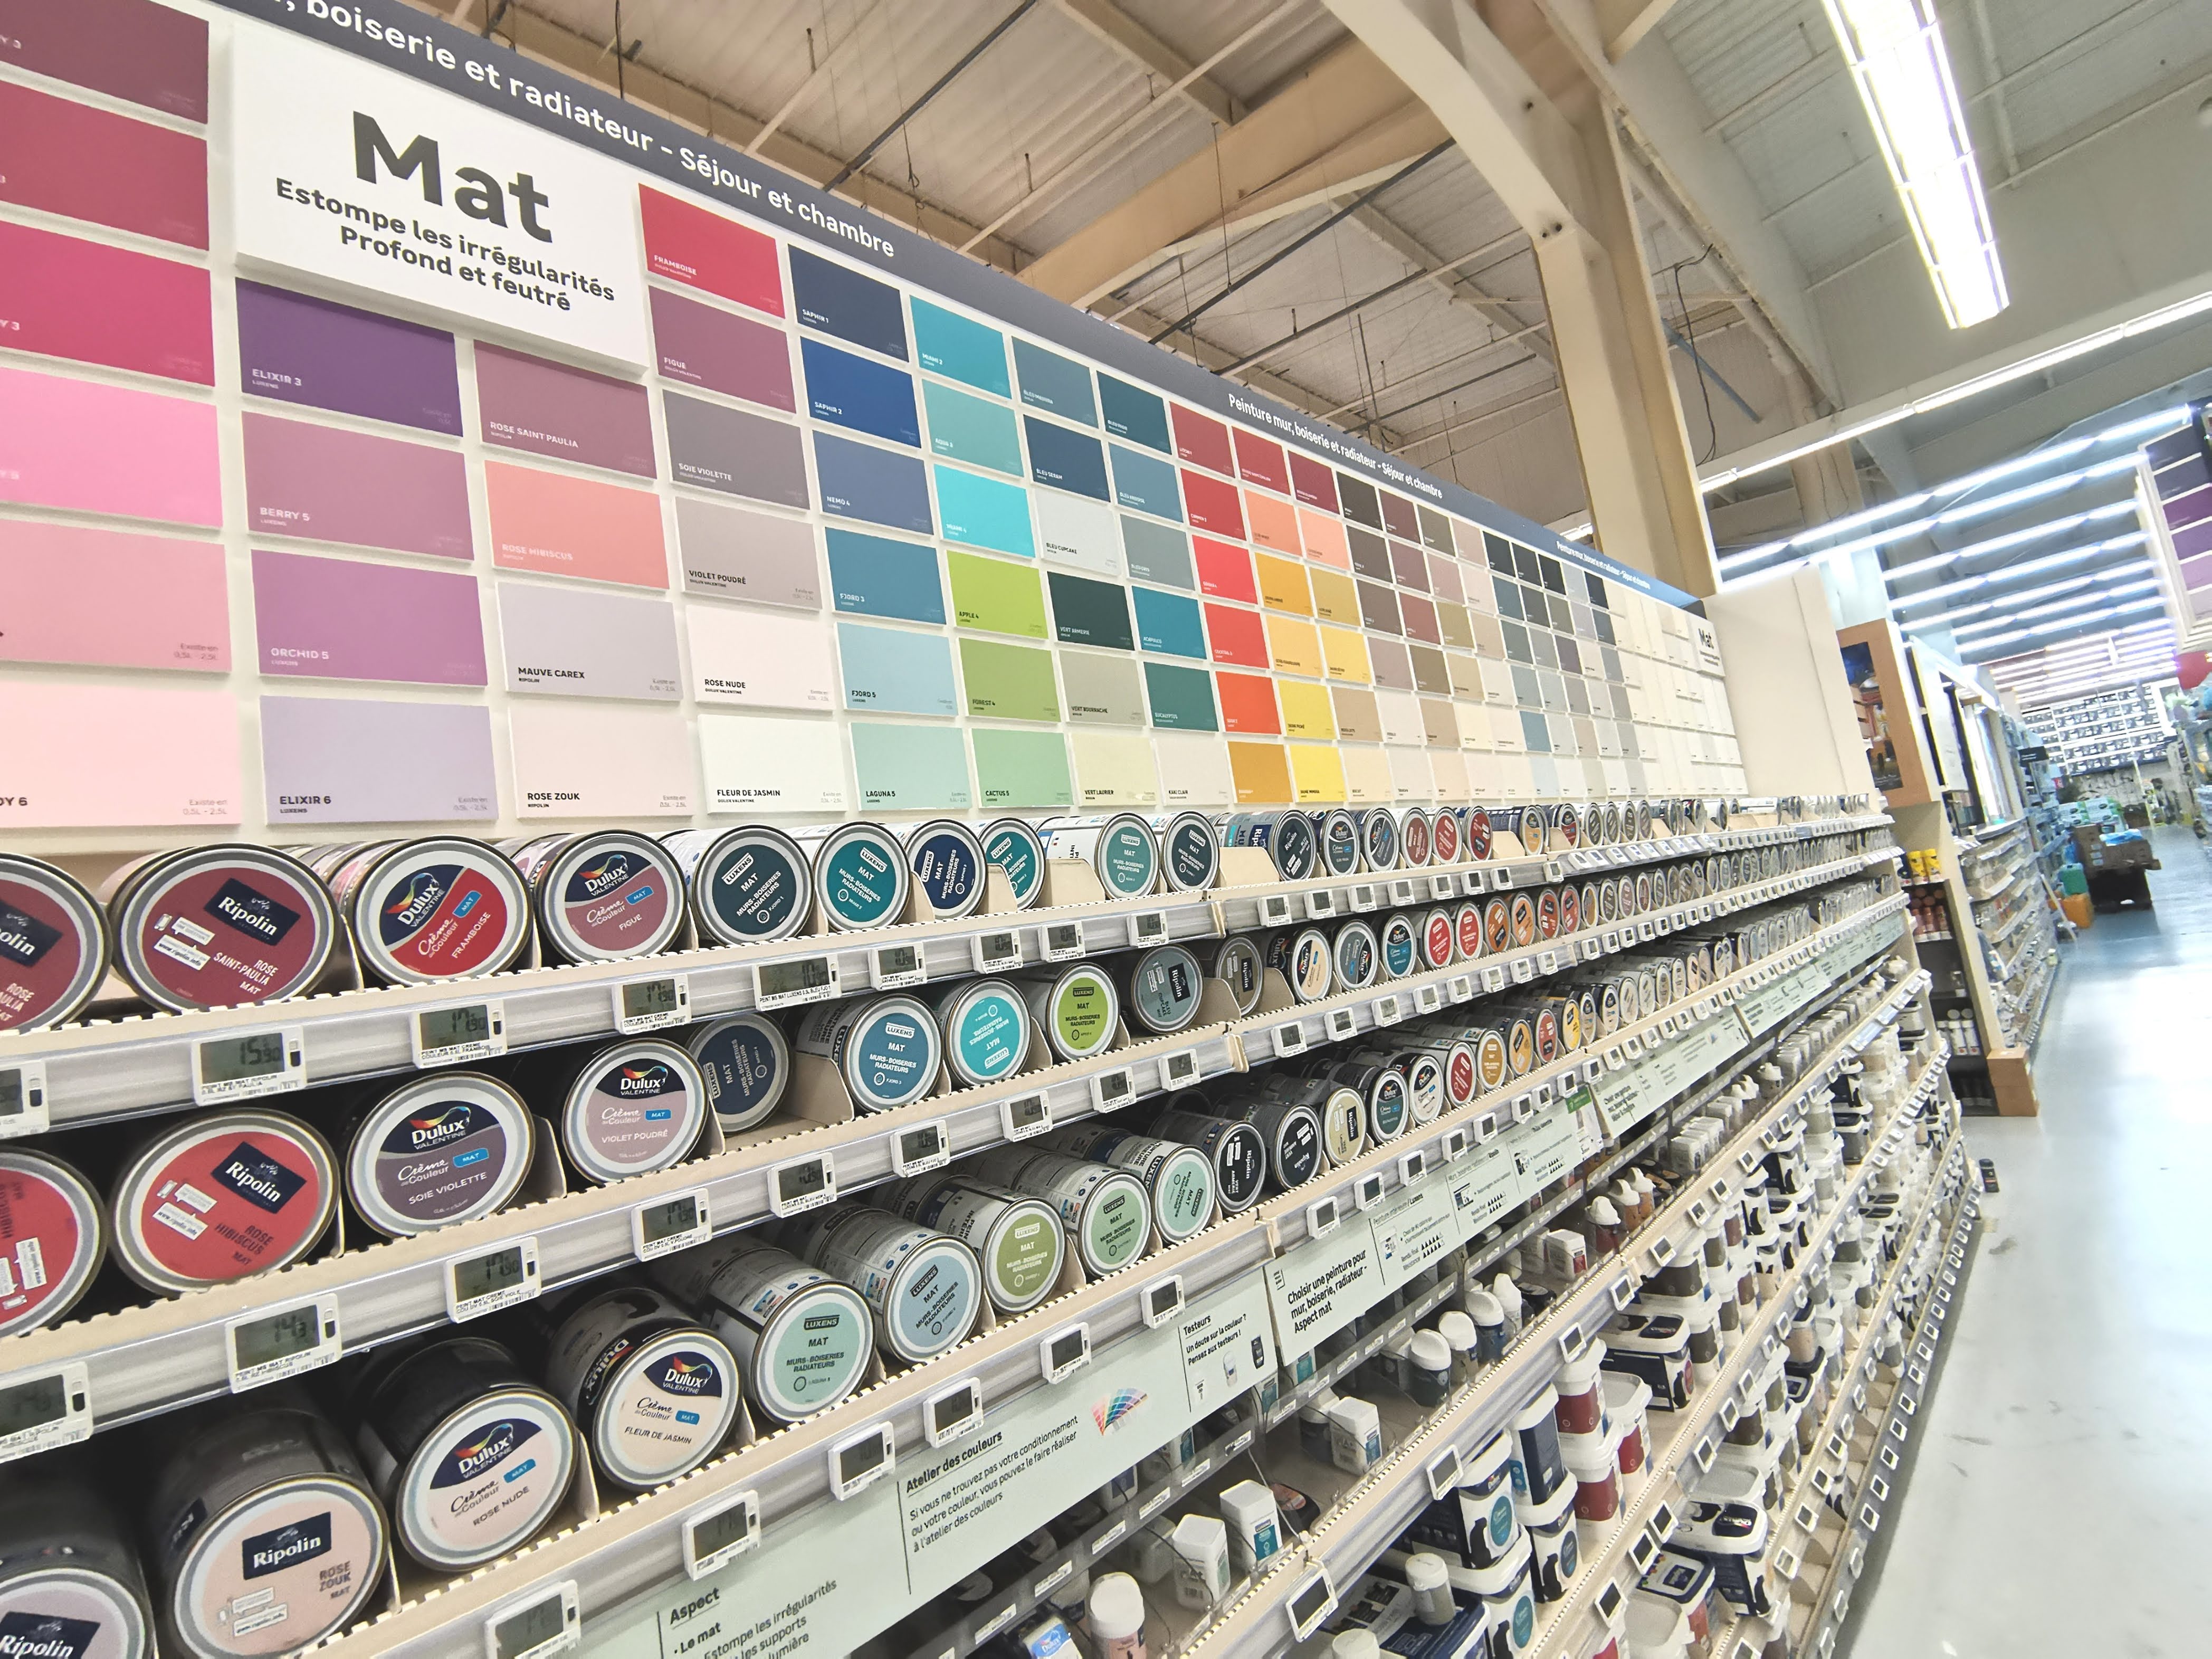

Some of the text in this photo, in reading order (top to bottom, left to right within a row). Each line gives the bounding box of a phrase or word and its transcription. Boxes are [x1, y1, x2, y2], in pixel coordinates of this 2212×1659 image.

[307, 0, 456, 70] boiserie
[465, 59, 500, 89] et
[510, 79, 653, 151] radiateur
[680, 148, 762, 197] Séjour
[768, 189, 794, 215] et
[798, 201, 894, 257] chambre
[352, 111, 552, 243] Mat
[276, 178, 615, 301] Estompe les irrégularités
[340, 226, 570, 311] Profond et feutré
[654, 254, 697, 276] FRAMBOISE
[664, 357, 686, 368] FIGUE
[252, 369, 302, 386] ELIXIR 3
[490, 422, 578, 448] ROSE SAINT PAULIA
[1229, 394, 1271, 423] Peinture
[1273, 416, 1294, 435] mur,
[1295, 422, 1330, 449] boiserie
[1331, 442, 1340, 452] et
[1341, 445, 1376, 470] radiateur
[1382, 462, 1404, 481] Séjour
[1406, 474, 1414, 483] et
[1414, 477, 1443, 499] chambre
[679, 463, 732, 481] SOIE VIOLETTE
[260, 507, 310, 522] BERRY 5
[502, 544, 527, 554] ROSE
[689, 570, 746, 585] VIOLET POUDRÉ
[271, 648, 329, 660] ORCHID 5
[518, 667, 585, 679] MAUVE CAREX
[279, 795, 331, 805] ELIXIR 6
[725, 855, 752, 883] LUXENS
[858, 866, 874, 881] MAT
[933, 862, 943, 880] MAT
[948, 858, 959, 894] RADIATEURS
[584, 870, 625, 893] Dulux
[590, 873, 629, 897] VALENTINE
[740, 873, 759, 892] MAT
[842, 878, 873, 903] RADIATEURS
[397, 885, 439, 926] Dulux
[410, 888, 445, 928] VALENTINE
[747, 881, 780, 915] RADIATEURS
[218, 897, 278, 936] Ripolin
[618, 913, 643, 931] FIGUE
[452, 911, 491, 959] FRAMBOISE
[213, 951, 270, 986] SAINT-PAULIA
[253, 959, 278, 976] ROSE
[240, 981, 261, 995] MAT
[1171, 970, 1183, 998] Ripolin
[887, 1025, 914, 1036] LUXENS
[888, 1042, 905, 1052] MAT
[869, 1054, 917, 1069] MURS-BOISERIES
[874, 1062, 909, 1073] RADIATEURS
[620, 1088, 661, 1096] VALENTINE
[621, 1078, 661, 1091] Dulux
[412, 1118, 465, 1145] Dulux
[414, 1129, 466, 1150] VALENTINE
[601, 1128, 669, 1144] VIOLET POUDRÉ
[225, 1160, 281, 1204] Ripolin
[408, 1171, 488, 1206] SOIE VIOLETTE
[214, 1223, 264, 1256] HIBISCUS
[244, 1224, 273, 1245] ROSE
[1020, 1242, 1035, 1252] MAT
[1288, 1250, 1367, 1305] Choisir une peinture pour
[923, 1285, 939, 1303] MAT
[1291, 1303, 1307, 1320] mur,
[1307, 1288, 1336, 1313] boiserie,
[1335, 1269, 1364, 1293] radiateur
[923, 1292, 956, 1327] RADIATEURS
[1294, 1302, 1332, 1333] Aspect mat
[805, 1318, 838, 1329] LUXENS
[1183, 1314, 1212, 1336] Testeurs
[1186, 1344, 1195, 1355] Un
[1195, 1334, 1210, 1351] doute
[1218, 1326, 1225, 1338] la
[1224, 1316, 1243, 1336] couleur
[808, 1337, 828, 1347] MAT
[786, 1352, 845, 1366] MURS-BOISERIES
[793, 1360, 835, 1372] RADIATEURS
[662, 1381, 699, 1395] VALENTINE
[665, 1368, 704, 1389] Dulux
[459, 1439, 508, 1474] Dulux
[463, 1446, 513, 1480] VALENTINE
[907, 1432, 1003, 1493] Atelier des couleurs
[909, 1415, 1079, 1521] Si vous ne trouvez pas votre conditionnement
[911, 1431, 1078, 1537] ou votre couleur, vous pouvez le faire réaliser
[473, 1485, 530, 1527] ROSE NUDE
[913, 1492, 1004, 1552] à l'atelier des couleurs
[253, 1534, 321, 1569] Ripolin
[319, 1572, 351, 1592] ZOUK
[320, 1561, 351, 1579] ROSE
[669, 1587, 720, 1626] Aspect
[704, 1580, 837, 1659] Estompe les irrégularités
[680, 1623, 721, 1655] Le mat
[740, 1615, 807, 1659] les supports
[768, 1633, 810, 1659] lumière
